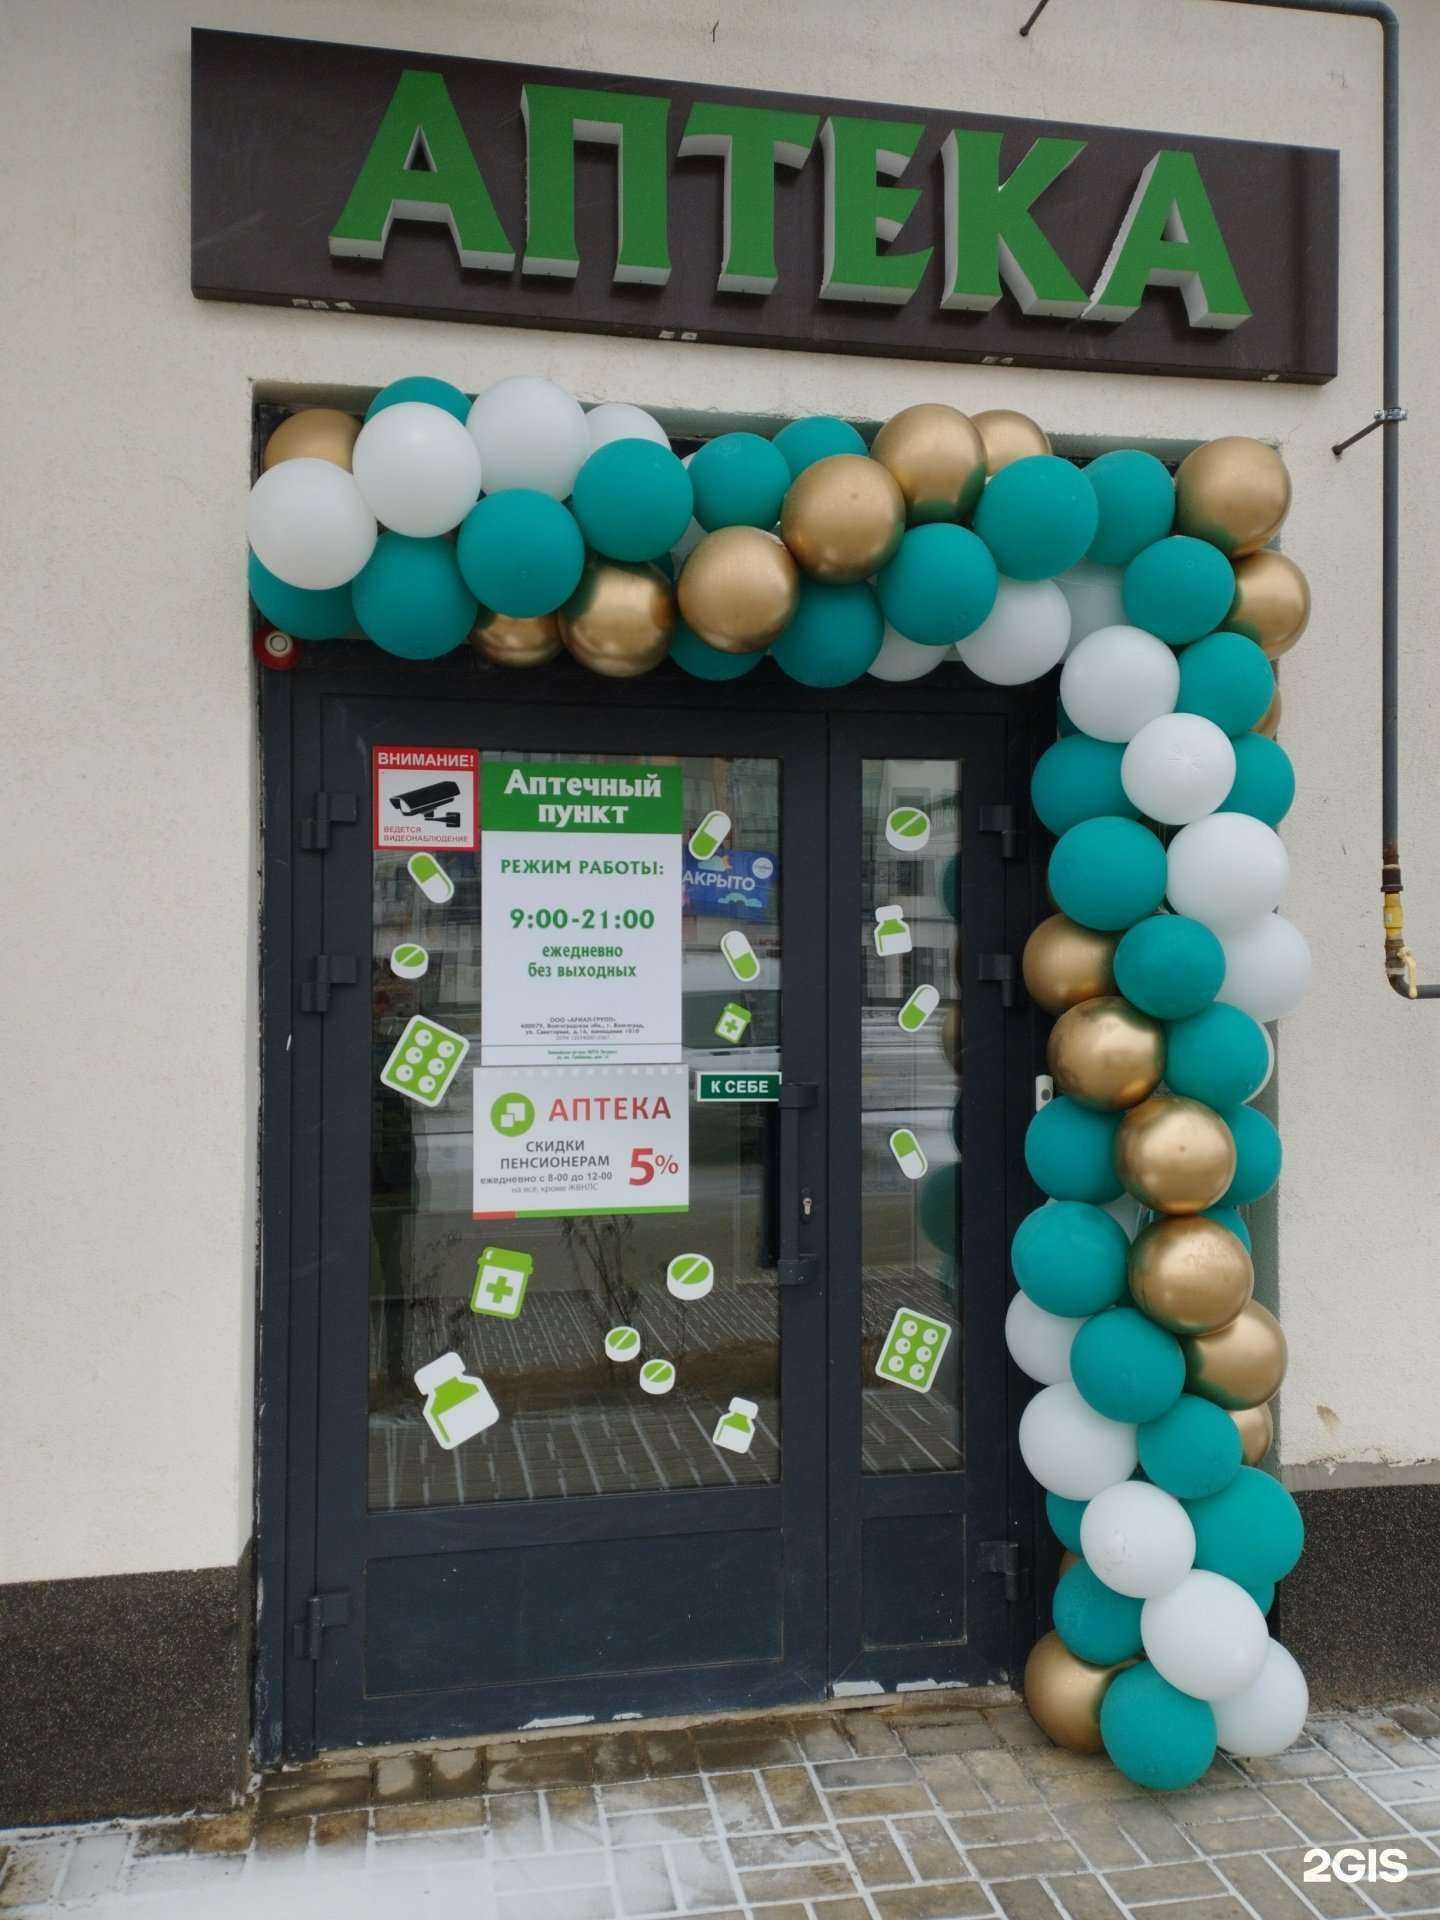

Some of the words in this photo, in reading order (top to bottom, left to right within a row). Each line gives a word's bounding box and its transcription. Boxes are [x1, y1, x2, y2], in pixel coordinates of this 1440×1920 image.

[328, 69, 1253, 331] АПТЕКА
[378, 752, 474, 767] ВНИМАНИЕ!
[503, 768, 663, 798] Аптечный
[537, 803, 630, 828] пункт
[383, 834, 468, 842] ВИДЕОНАБЛЮДЕНИЕ
[500, 858, 572, 875] РЕЖИМ
[578, 859, 665, 876] РАБОТЫ:
[681, 869, 756, 892] АКРЫТО
[509, 907, 656, 930] 9:00-21:00
[541, 945, 624, 960] ежедневно
[527, 961, 552, 978] без
[556, 964, 637, 980] выходных
[711, 1080, 721, 1093] К
[724, 1080, 769, 1093] СЕБЕ
[548, 1096, 672, 1122] АПТЕКА
[525, 1139, 585, 1154] СКИДКИ
[500, 1155, 611, 1170] ПЕНСИОНЕРАМ
[628, 1147, 680, 1187] 5%
[480, 1175, 537, 1185] ежедневно
[539, 1175, 545, 1183] с
[547, 1173, 568, 1183] 8-00
[571, 1174, 584, 1184] до
[587, 1171, 613, 1181] 12-00
